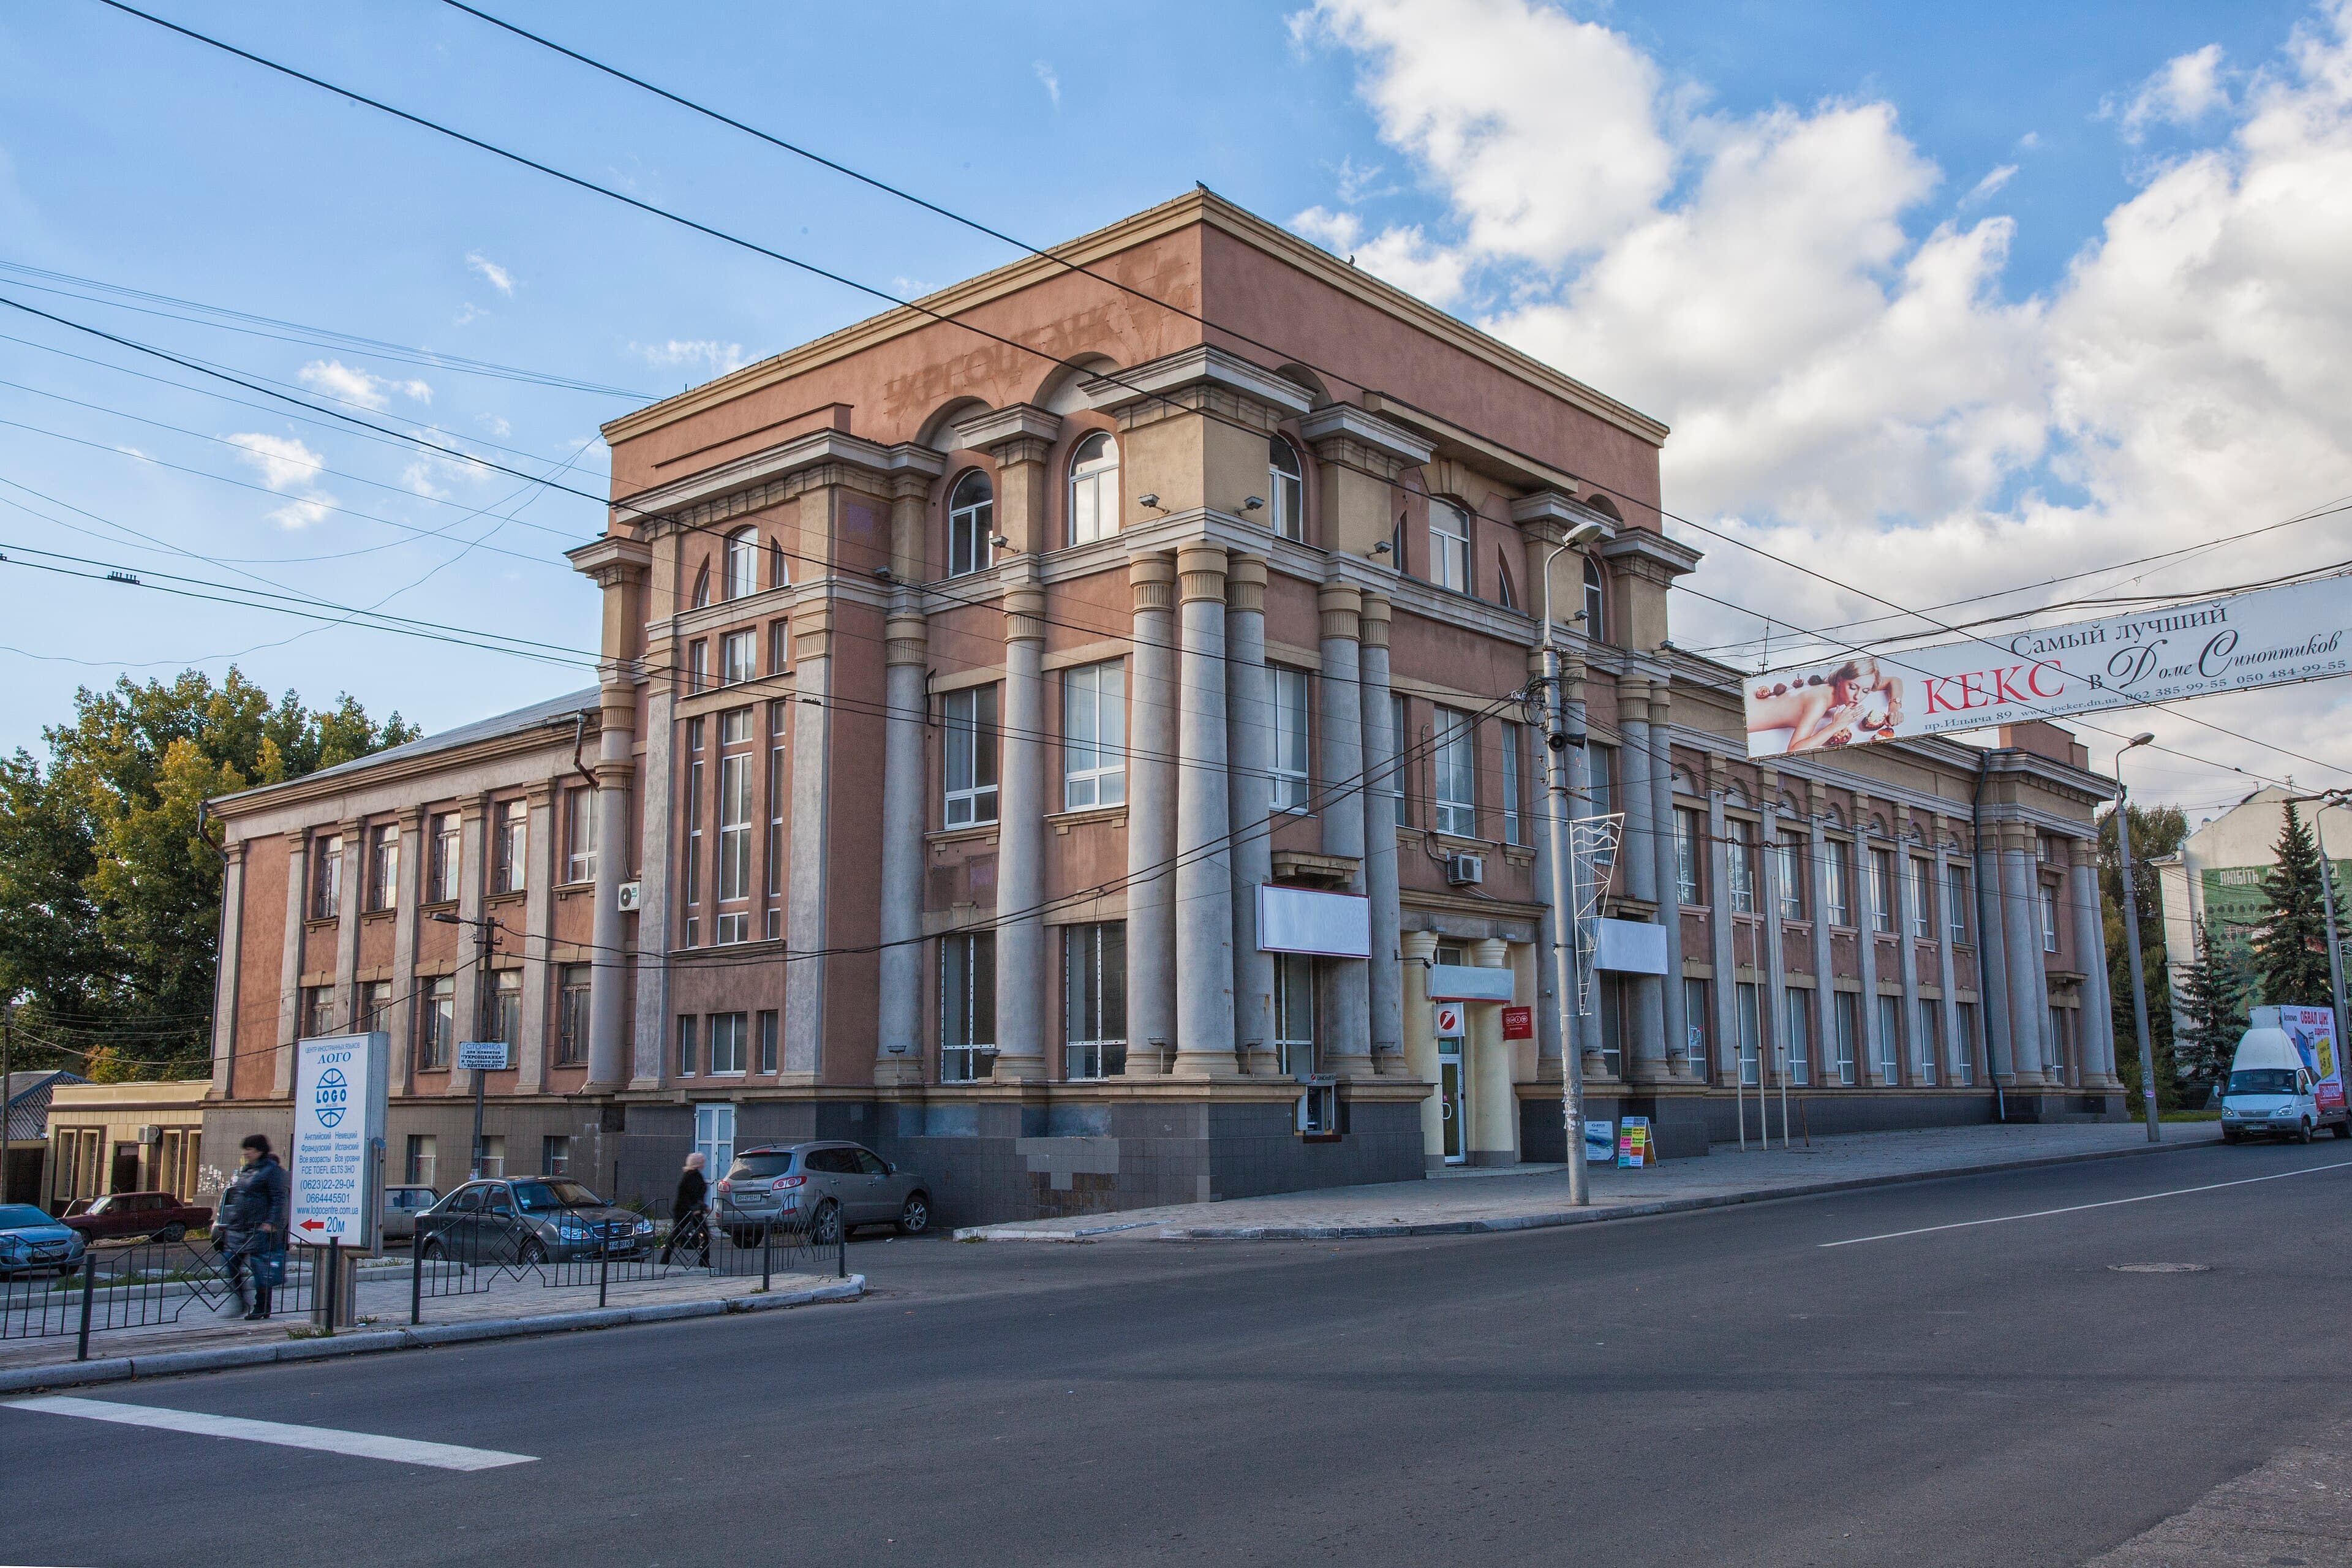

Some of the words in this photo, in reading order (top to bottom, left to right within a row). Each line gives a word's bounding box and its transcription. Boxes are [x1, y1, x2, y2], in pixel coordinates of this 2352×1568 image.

[2010, 623, 2106, 657] Самый
[2116, 602, 2228, 644] лучший
[1920, 660, 2065, 715] КЕКС
[2107, 639, 2193, 690] Доме
[2198, 629, 2342, 678] Синоптиков
[1924, 715, 1992, 731] пр.Ильича
[1996, 710, 2012, 720] 89
[2021, 696, 2117, 717] www.jocker.dn.ua
[2125, 690, 2150, 701] 062
[2155, 678, 2227, 697] 385-99-55
[2237, 673, 2263, 685] 050
[2268, 660, 2346, 679] 484-99-55
[2220, 868, 2259, 886] ЛЮБІТЬ
[2284, 1012, 2297, 1021] lenovo
[318, 1044, 344, 1052] ИНОСТРАННЫХ
[317, 1052, 351, 1064] ЛОГО
[316, 1088, 346, 1103] LOGO
[335, 1131, 357, 1139] Немецкий
[301, 1143, 331, 1153] Французский
[344, 1155, 360, 1164] уровни
[301, 1166, 312, 1174] FCE
[314, 1166, 328, 1174] TOEFL
[330, 1165, 343, 1174] IELTS
[300, 1179, 355, 1191] (0623)22-29-04
[306, 1193, 350, 1203] 0664445501
[296, 1205, 358, 1216] www.logocentre.com.ua
